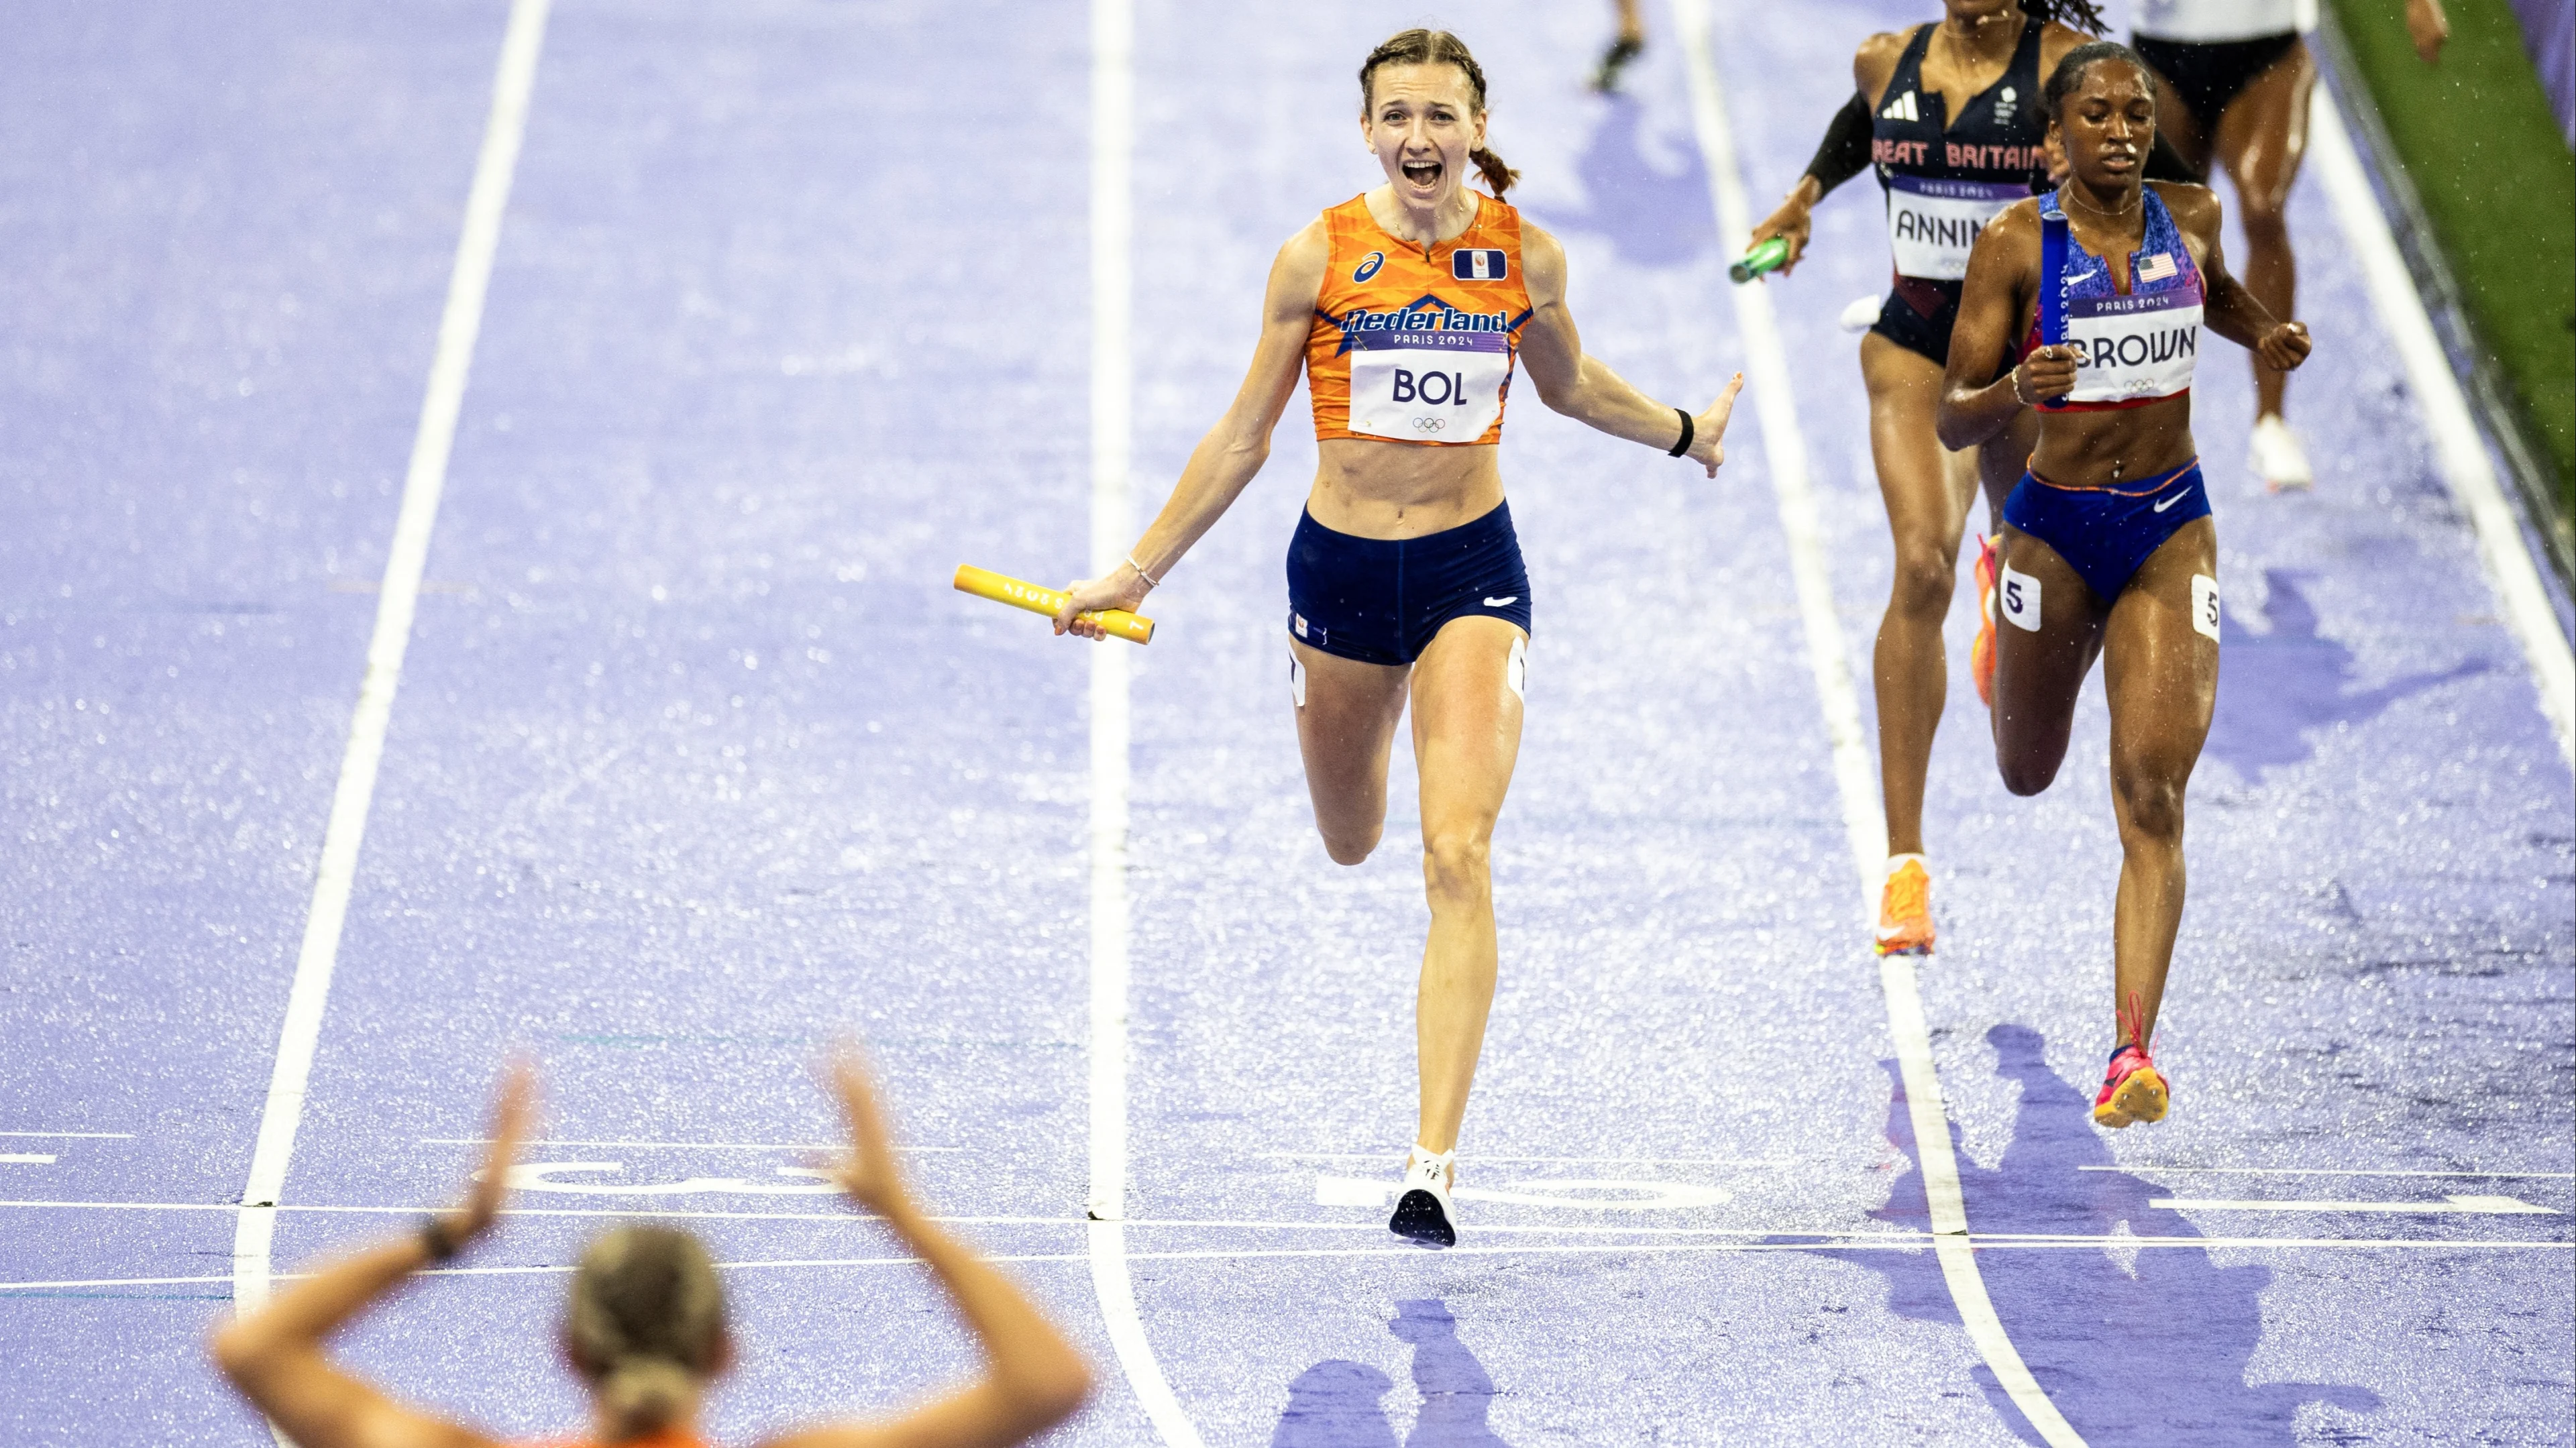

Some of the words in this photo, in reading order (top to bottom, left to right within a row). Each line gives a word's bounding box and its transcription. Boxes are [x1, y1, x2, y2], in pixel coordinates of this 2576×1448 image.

[2096, 299, 2134, 312] PARIS
[2138, 295, 2169, 309] 2024
[1394, 334, 1434, 345] PARIS
[1438, 335, 1473, 346] 2024
[1392, 368, 1468, 406] BOL
[2005, 580, 2024, 614] 5
[2207, 590, 2218, 628] 5
